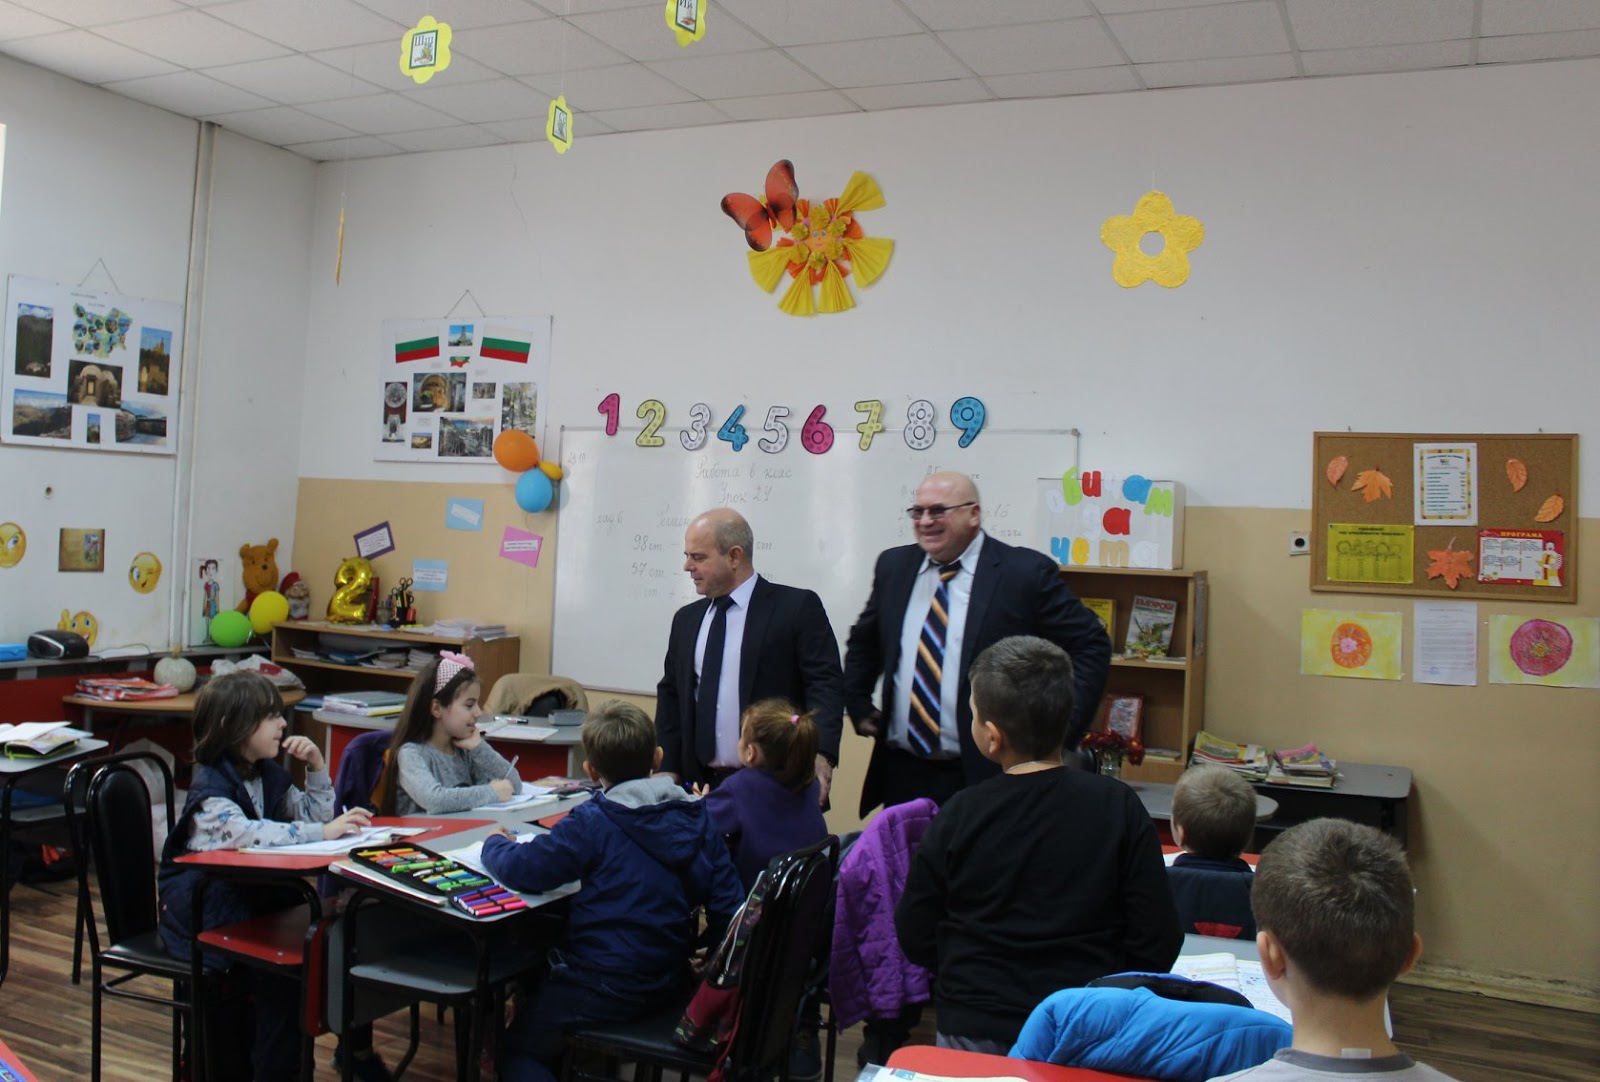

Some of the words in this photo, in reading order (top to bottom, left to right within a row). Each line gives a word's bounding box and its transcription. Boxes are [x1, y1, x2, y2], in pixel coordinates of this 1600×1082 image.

[598, 393, 620, 436] 1
[636, 400, 666, 447] 2
[679, 403, 711, 451] 3
[717, 404, 749, 452] 4
[757, 406, 790, 454] 5
[801, 404, 834, 455] 6
[854, 400, 883, 451] 7
[903, 400, 936, 451] 8
[950, 396, 986, 448] 9
[1500, 531, 1543, 539] ПРОГРАМА
[326, 556, 374, 624] 2
